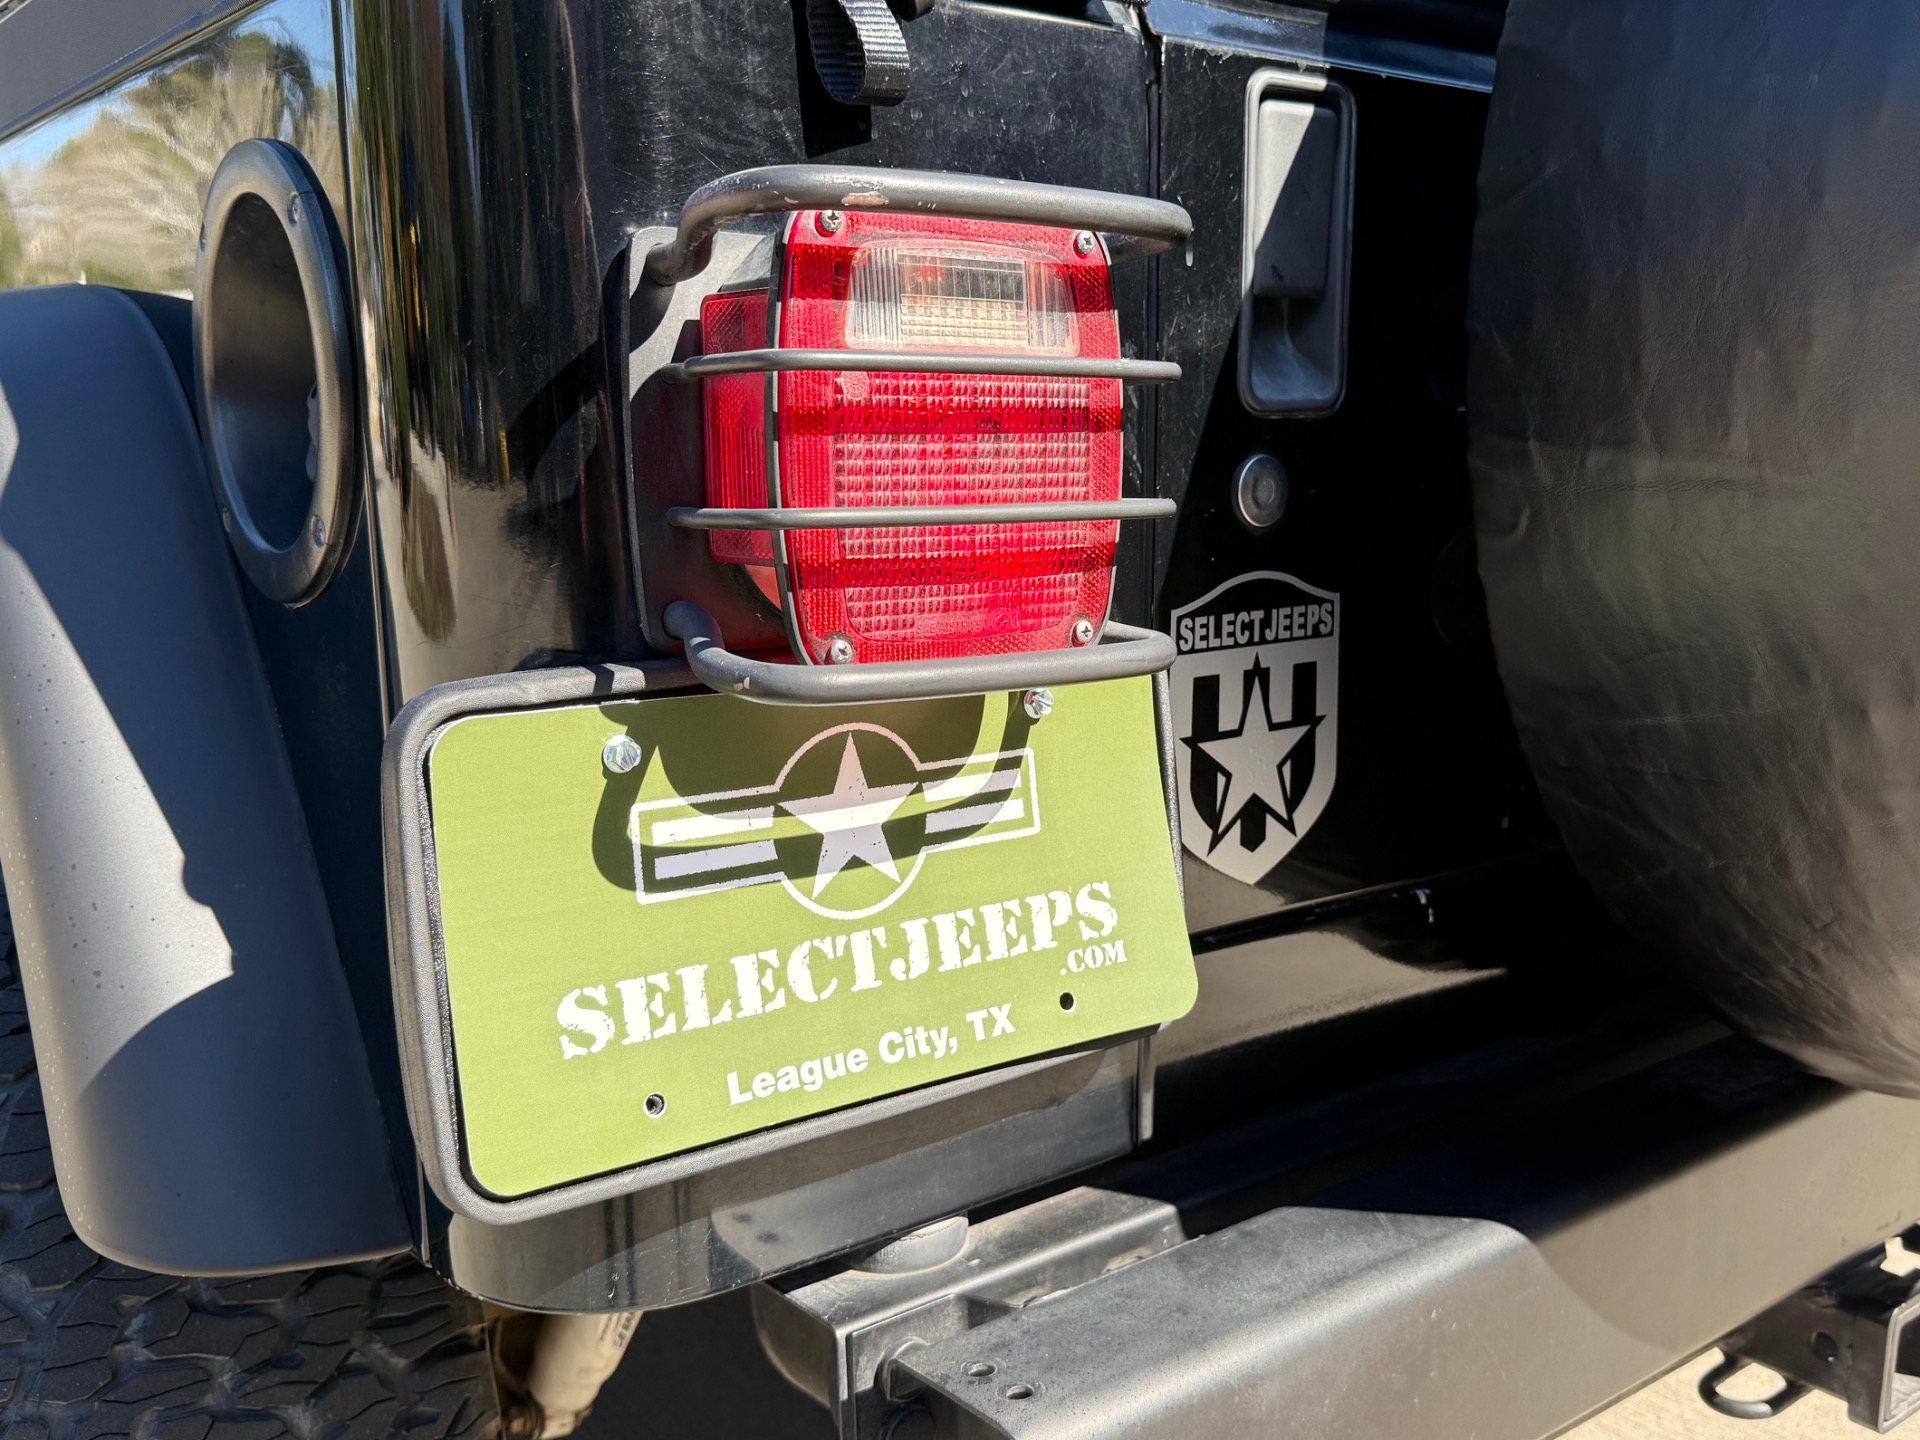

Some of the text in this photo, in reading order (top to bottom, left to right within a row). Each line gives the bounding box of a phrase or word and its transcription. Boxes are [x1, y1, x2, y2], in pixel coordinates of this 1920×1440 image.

[1178, 602, 1334, 652] SELECTJEEPS
[556, 880, 1119, 1061] SELECTJEEPS
[1059, 939, 1128, 976] .COM
[726, 1002, 1017, 1106] League City, TX
